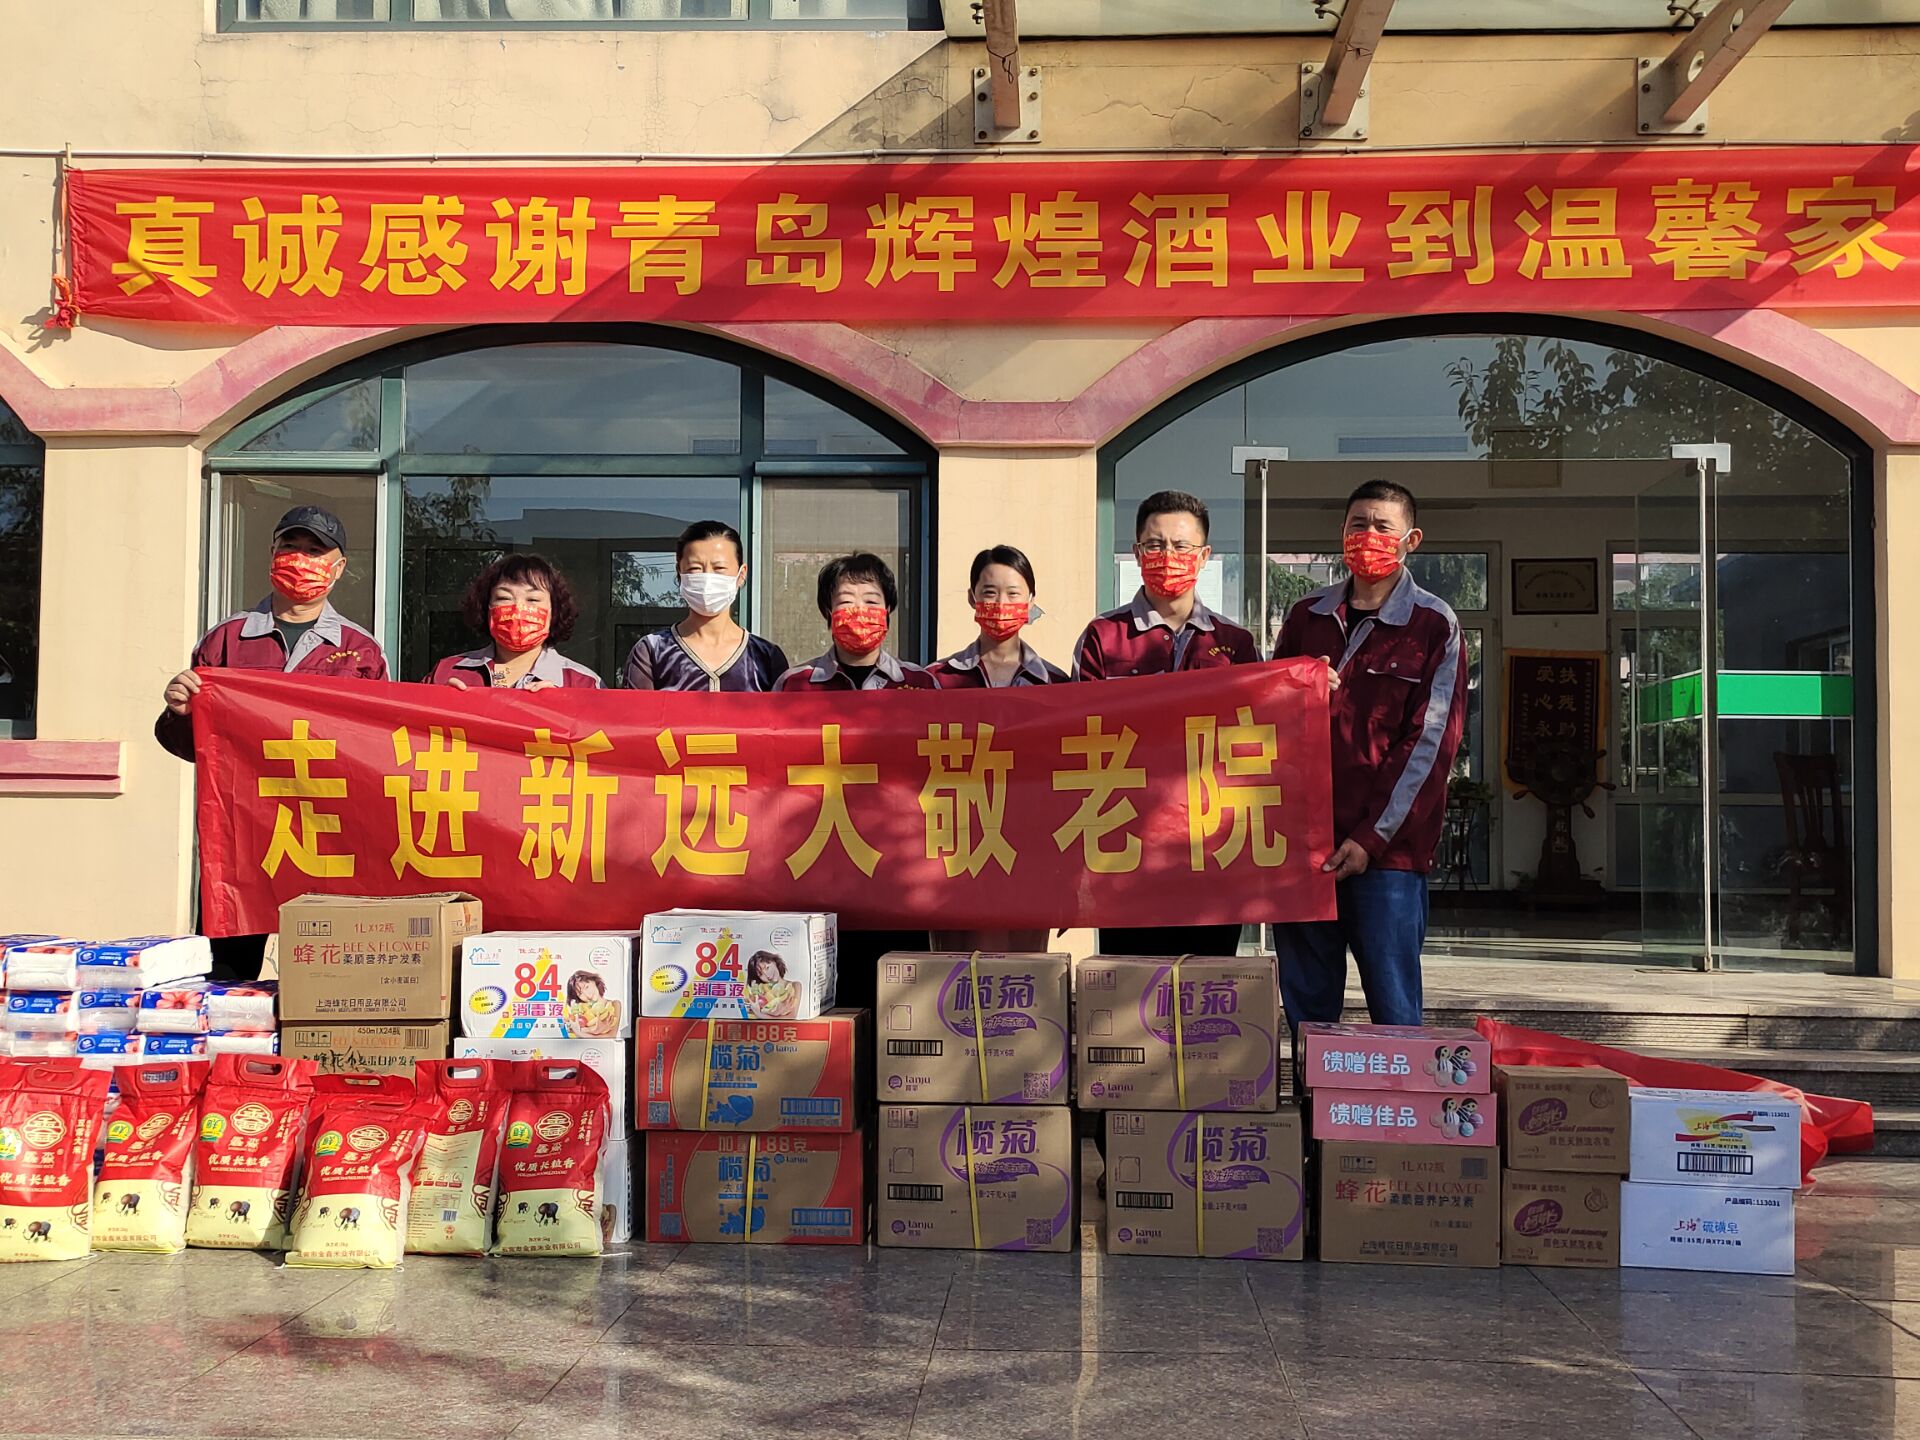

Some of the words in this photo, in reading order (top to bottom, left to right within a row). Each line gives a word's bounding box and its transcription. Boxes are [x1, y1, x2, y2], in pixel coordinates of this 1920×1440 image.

[111, 175, 1905, 299] 真诚感谢青岛辉煌酒业到温馨家
[257, 705, 1288, 884] 走进新远大敬老院
[354, 923, 366, 934] 1L
[293, 943, 341, 965] 蜂花
[343, 942, 364, 953] BEE
[367, 942, 376, 952] &
[379, 941, 430, 953] FLOWER
[343, 953, 422, 965] 柔顺营养护发素
[695, 942, 743, 979] 84
[514, 962, 562, 999] 84
[692, 983, 744, 997] 消毒液
[315, 998, 407, 1008] 上海蜂花日用品有限公司
[954, 974, 1036, 1011] 榄菊
[1156, 980, 1239, 1018] 榄菊
[512, 1003, 564, 1017] 消毒液
[711, 1044, 760, 1071] 榄菊
[1322, 1050, 1411, 1075] 馈赠佳品
[906, 1075, 931, 1086] lanju
[1107, 1083, 1134, 1093] lanju
[1329, 1102, 1418, 1128] 馈赠佳品
[956, 1119, 1037, 1156] 榄菊
[1184, 1126, 1268, 1163] 榄菊
[207, 1154, 272, 1167] 优质长粒香
[514, 1158, 576, 1172] 优质长粒香
[718, 1156, 771, 1182] 榄菊
[1335, 1179, 1387, 1203] 蜂花
[908, 1219, 934, 1230] lanju
[1135, 1227, 1162, 1238] lanju
